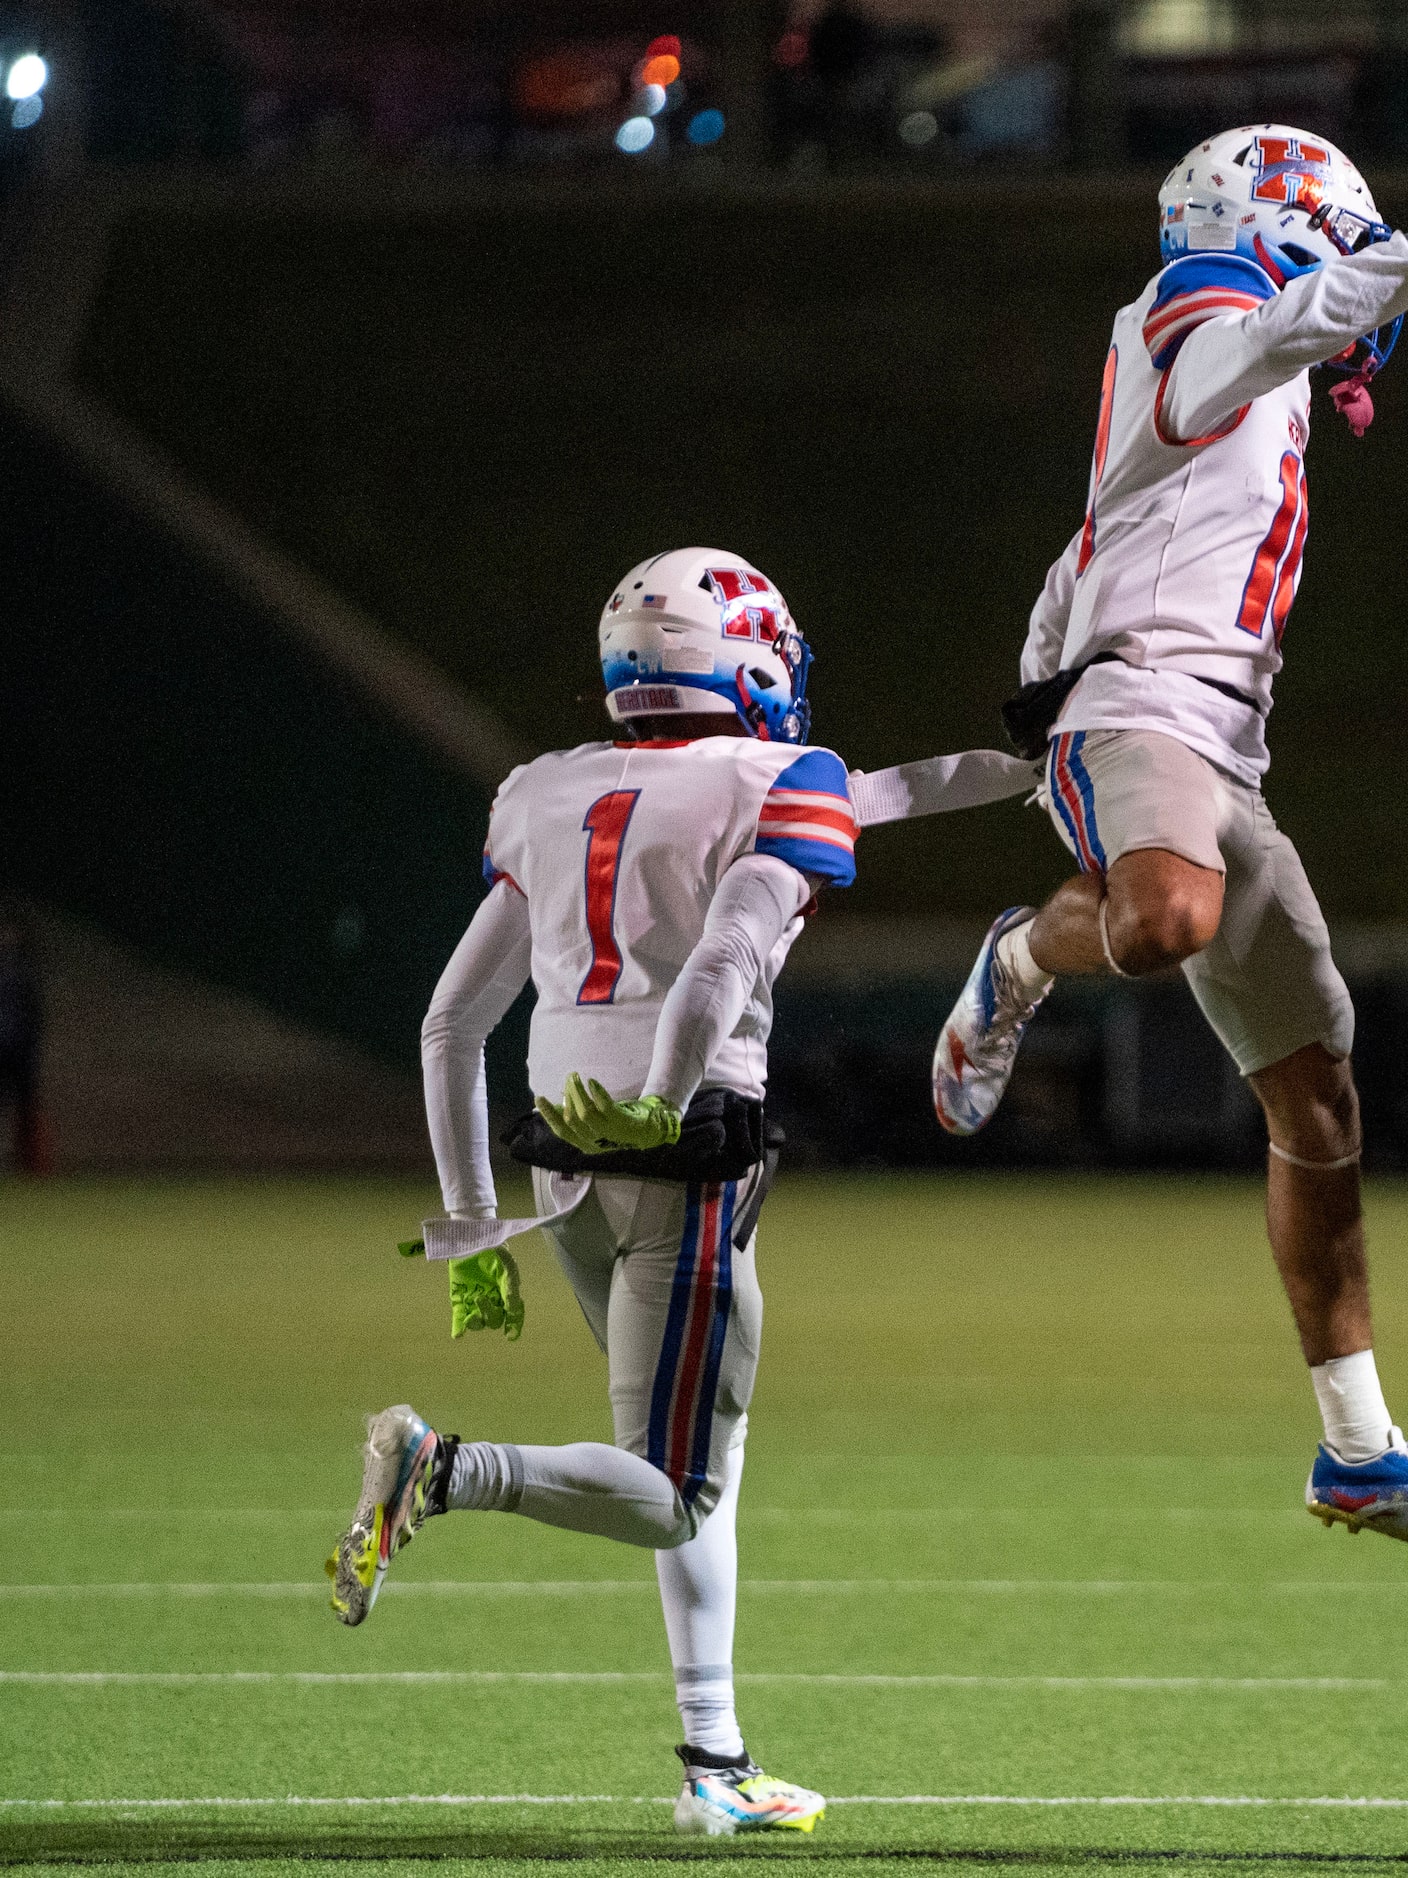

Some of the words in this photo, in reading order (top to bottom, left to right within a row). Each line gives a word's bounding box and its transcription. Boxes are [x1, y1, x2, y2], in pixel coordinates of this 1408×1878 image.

[1251, 136, 1331, 214] H
[705, 568, 780, 645] H
[576, 788, 642, 1005] 1
